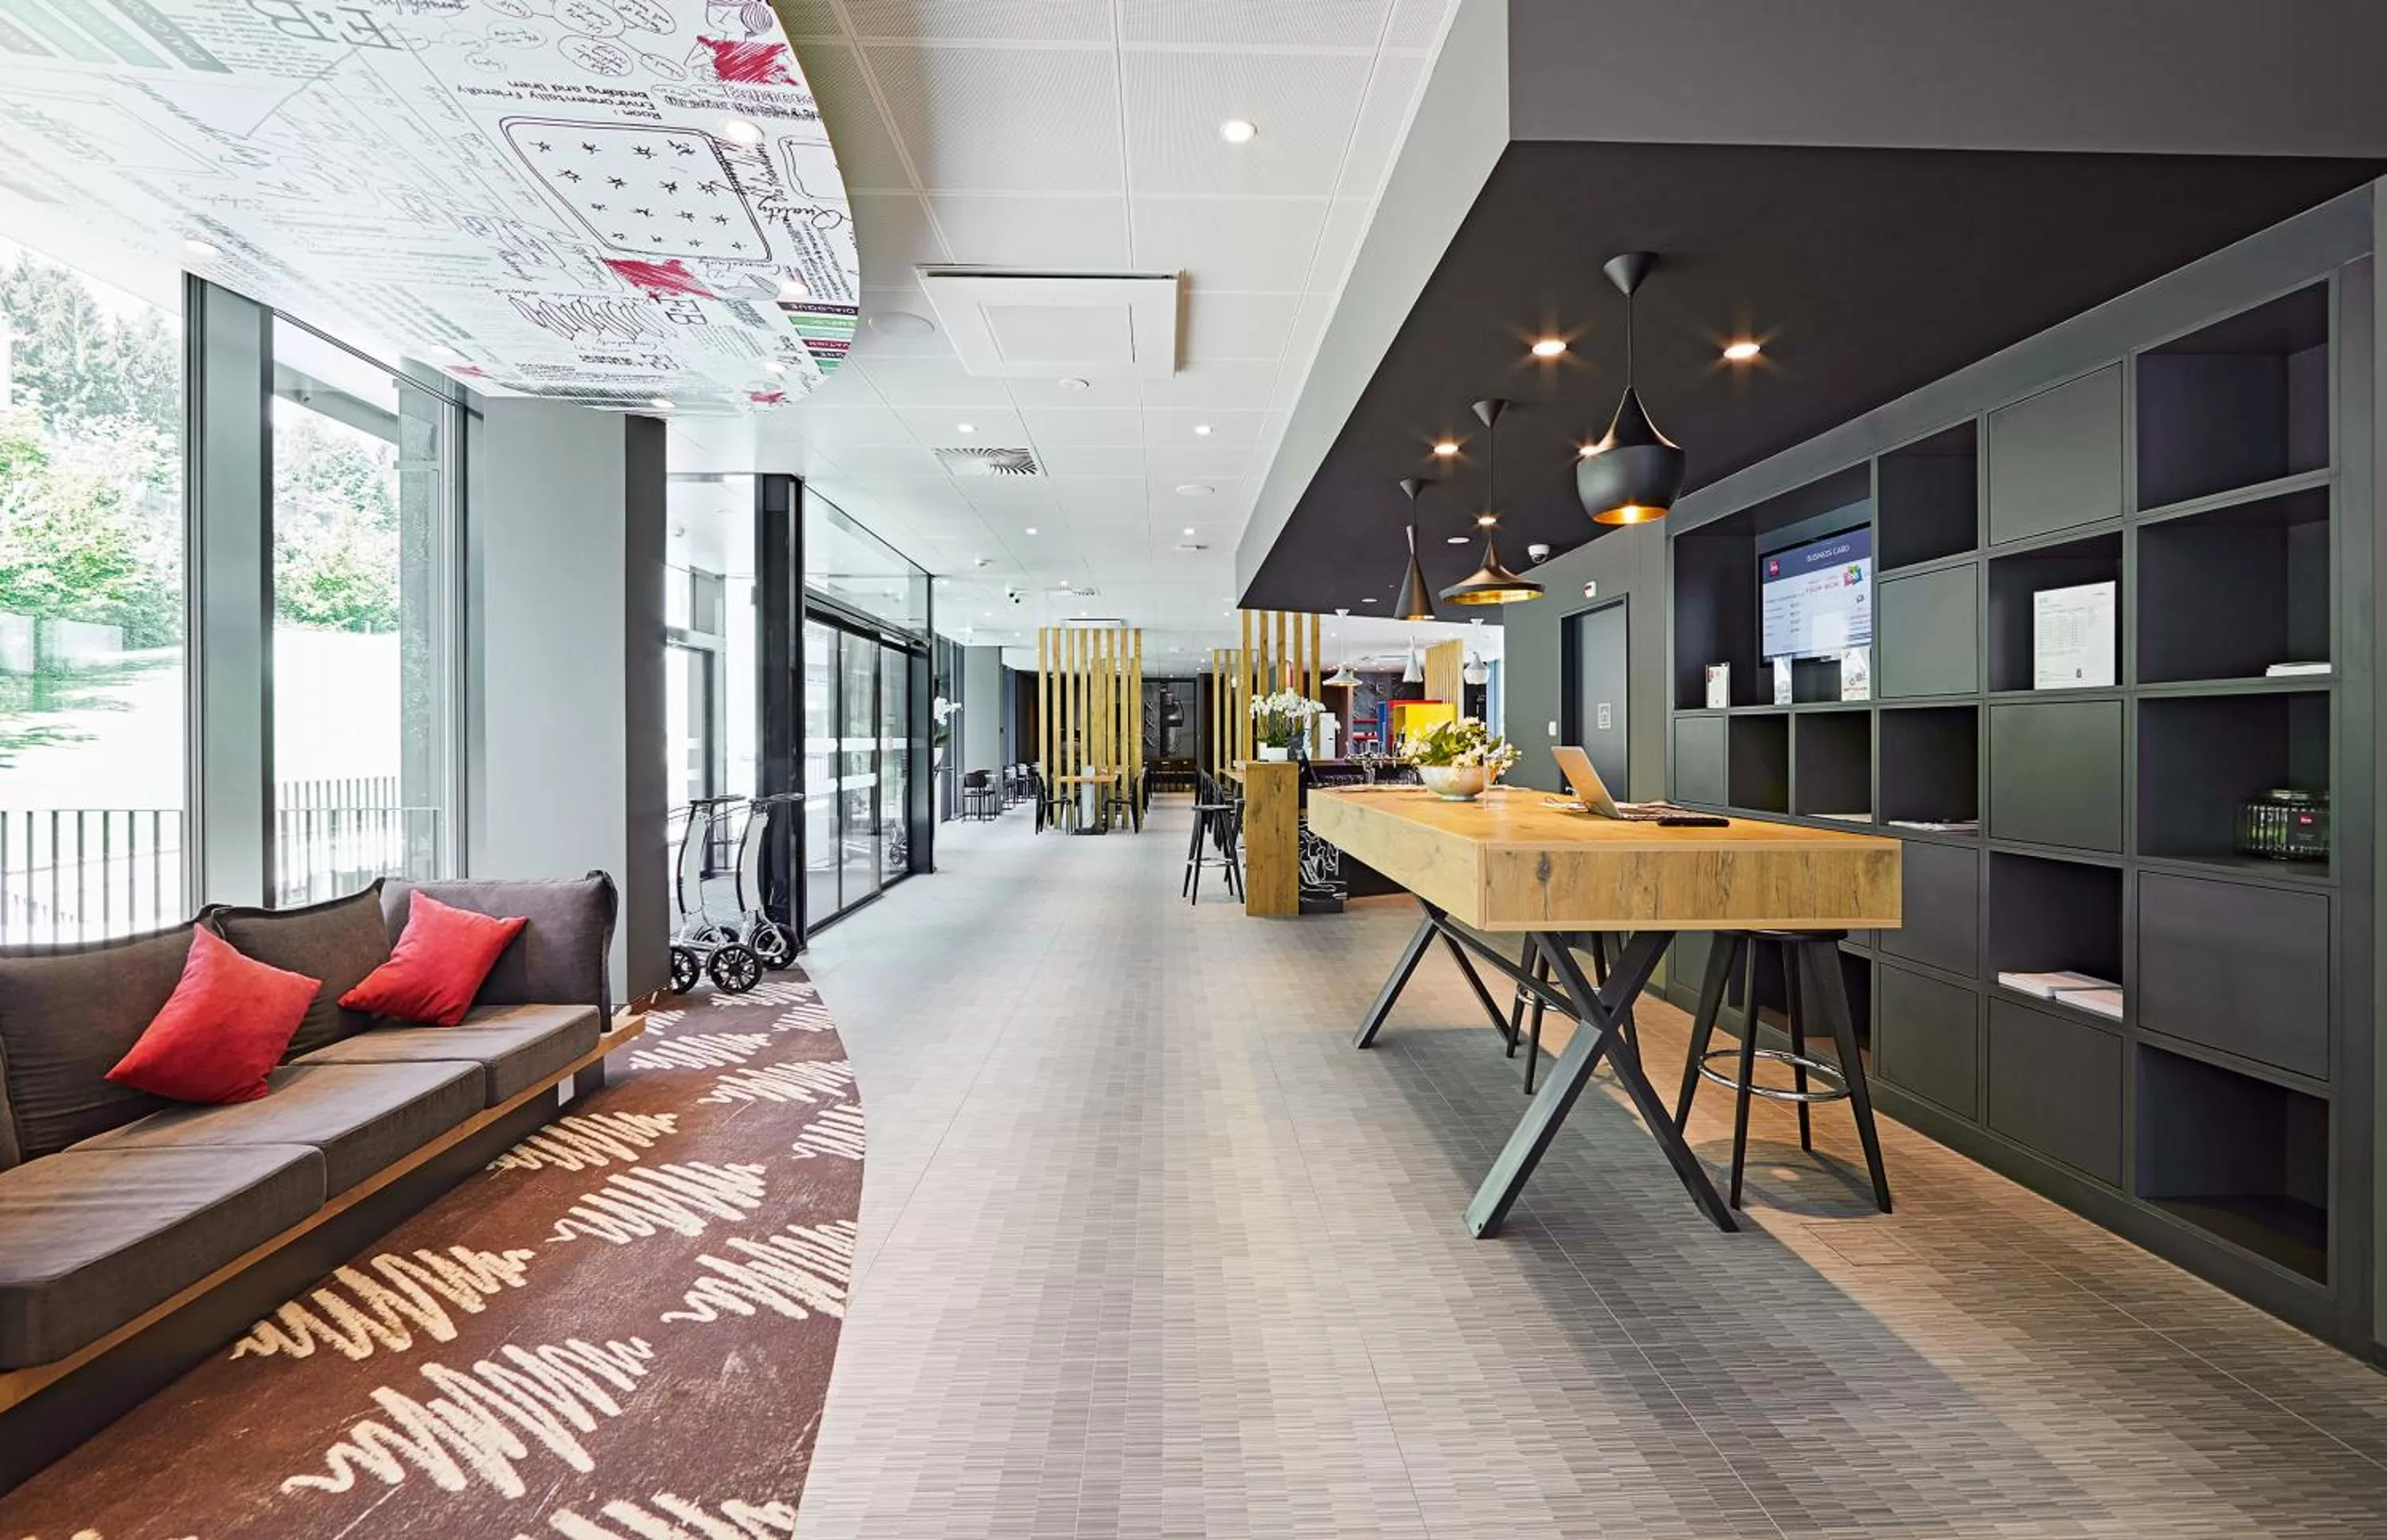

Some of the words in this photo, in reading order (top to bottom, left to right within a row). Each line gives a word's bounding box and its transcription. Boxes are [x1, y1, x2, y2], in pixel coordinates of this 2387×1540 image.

[507, 81, 547, 92] linen
[551, 84, 582, 94] and
[586, 85, 649, 100] bedding
[529, 90, 656, 111] Environmentally
[622, 109, 663, 121] Room
[757, 195, 843, 230] Quality
[790, 305, 855, 315] DIALOGUE
[1833, 544, 1850, 555] CARD
